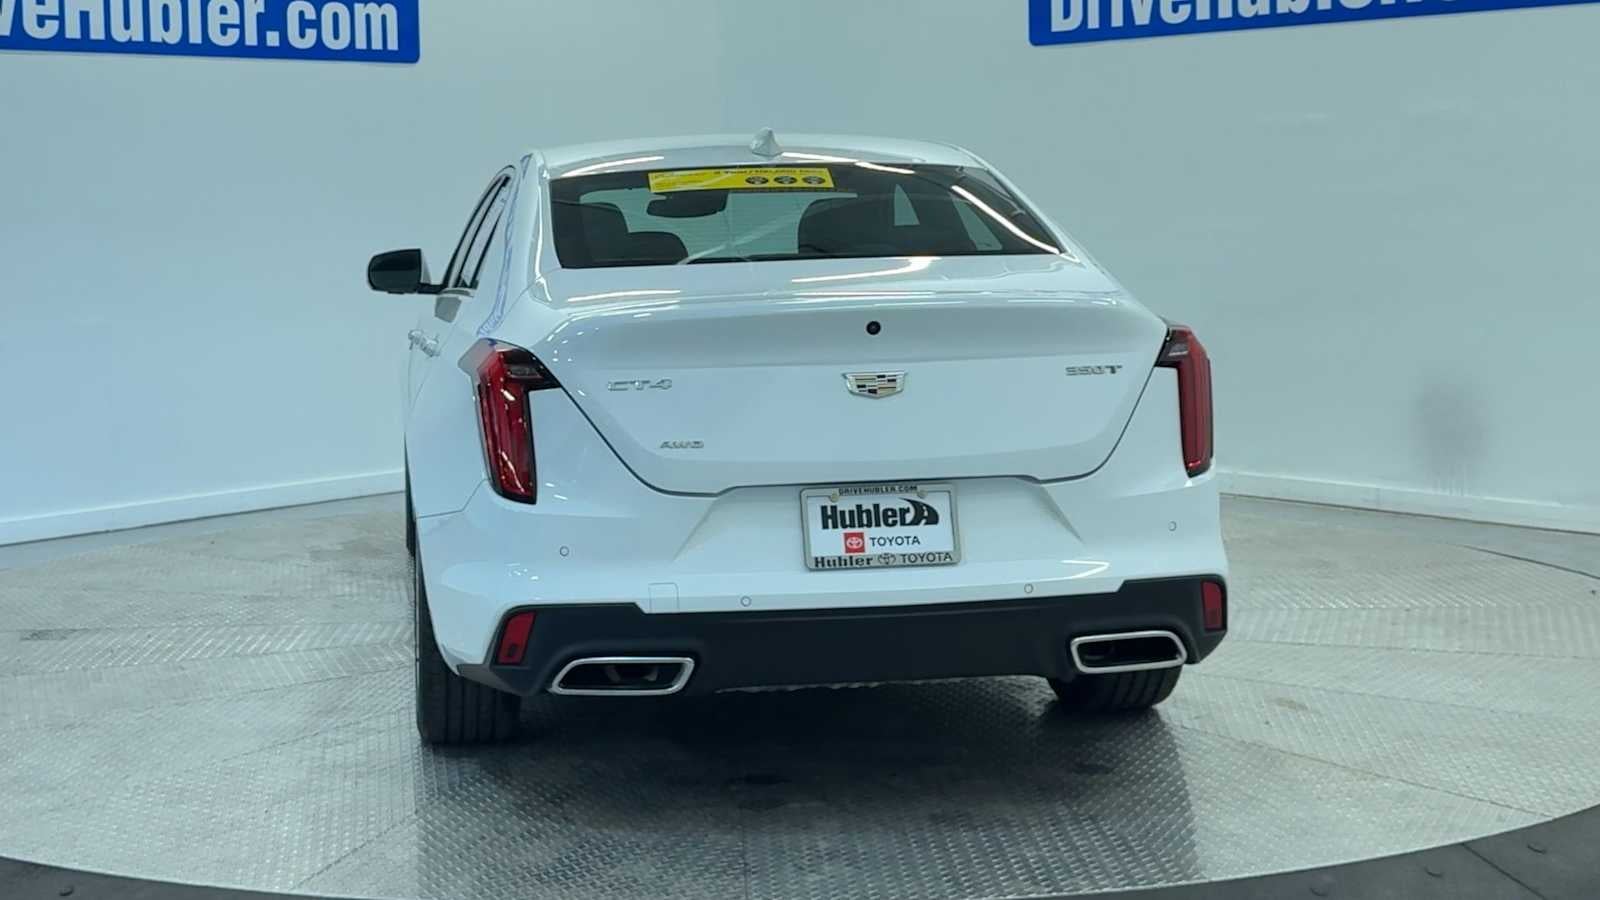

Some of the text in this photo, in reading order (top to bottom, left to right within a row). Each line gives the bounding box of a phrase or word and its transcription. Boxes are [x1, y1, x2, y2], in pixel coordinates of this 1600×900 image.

[607, 378, 673, 392] CT4
[660, 440, 704, 449] AWD
[838, 485, 918, 496] DRIVEHUBLER.COM
[820, 503, 911, 530] Hubler
[869, 535, 921, 547] TOYOTA
[814, 551, 954, 568] Hubler TOYOTA
